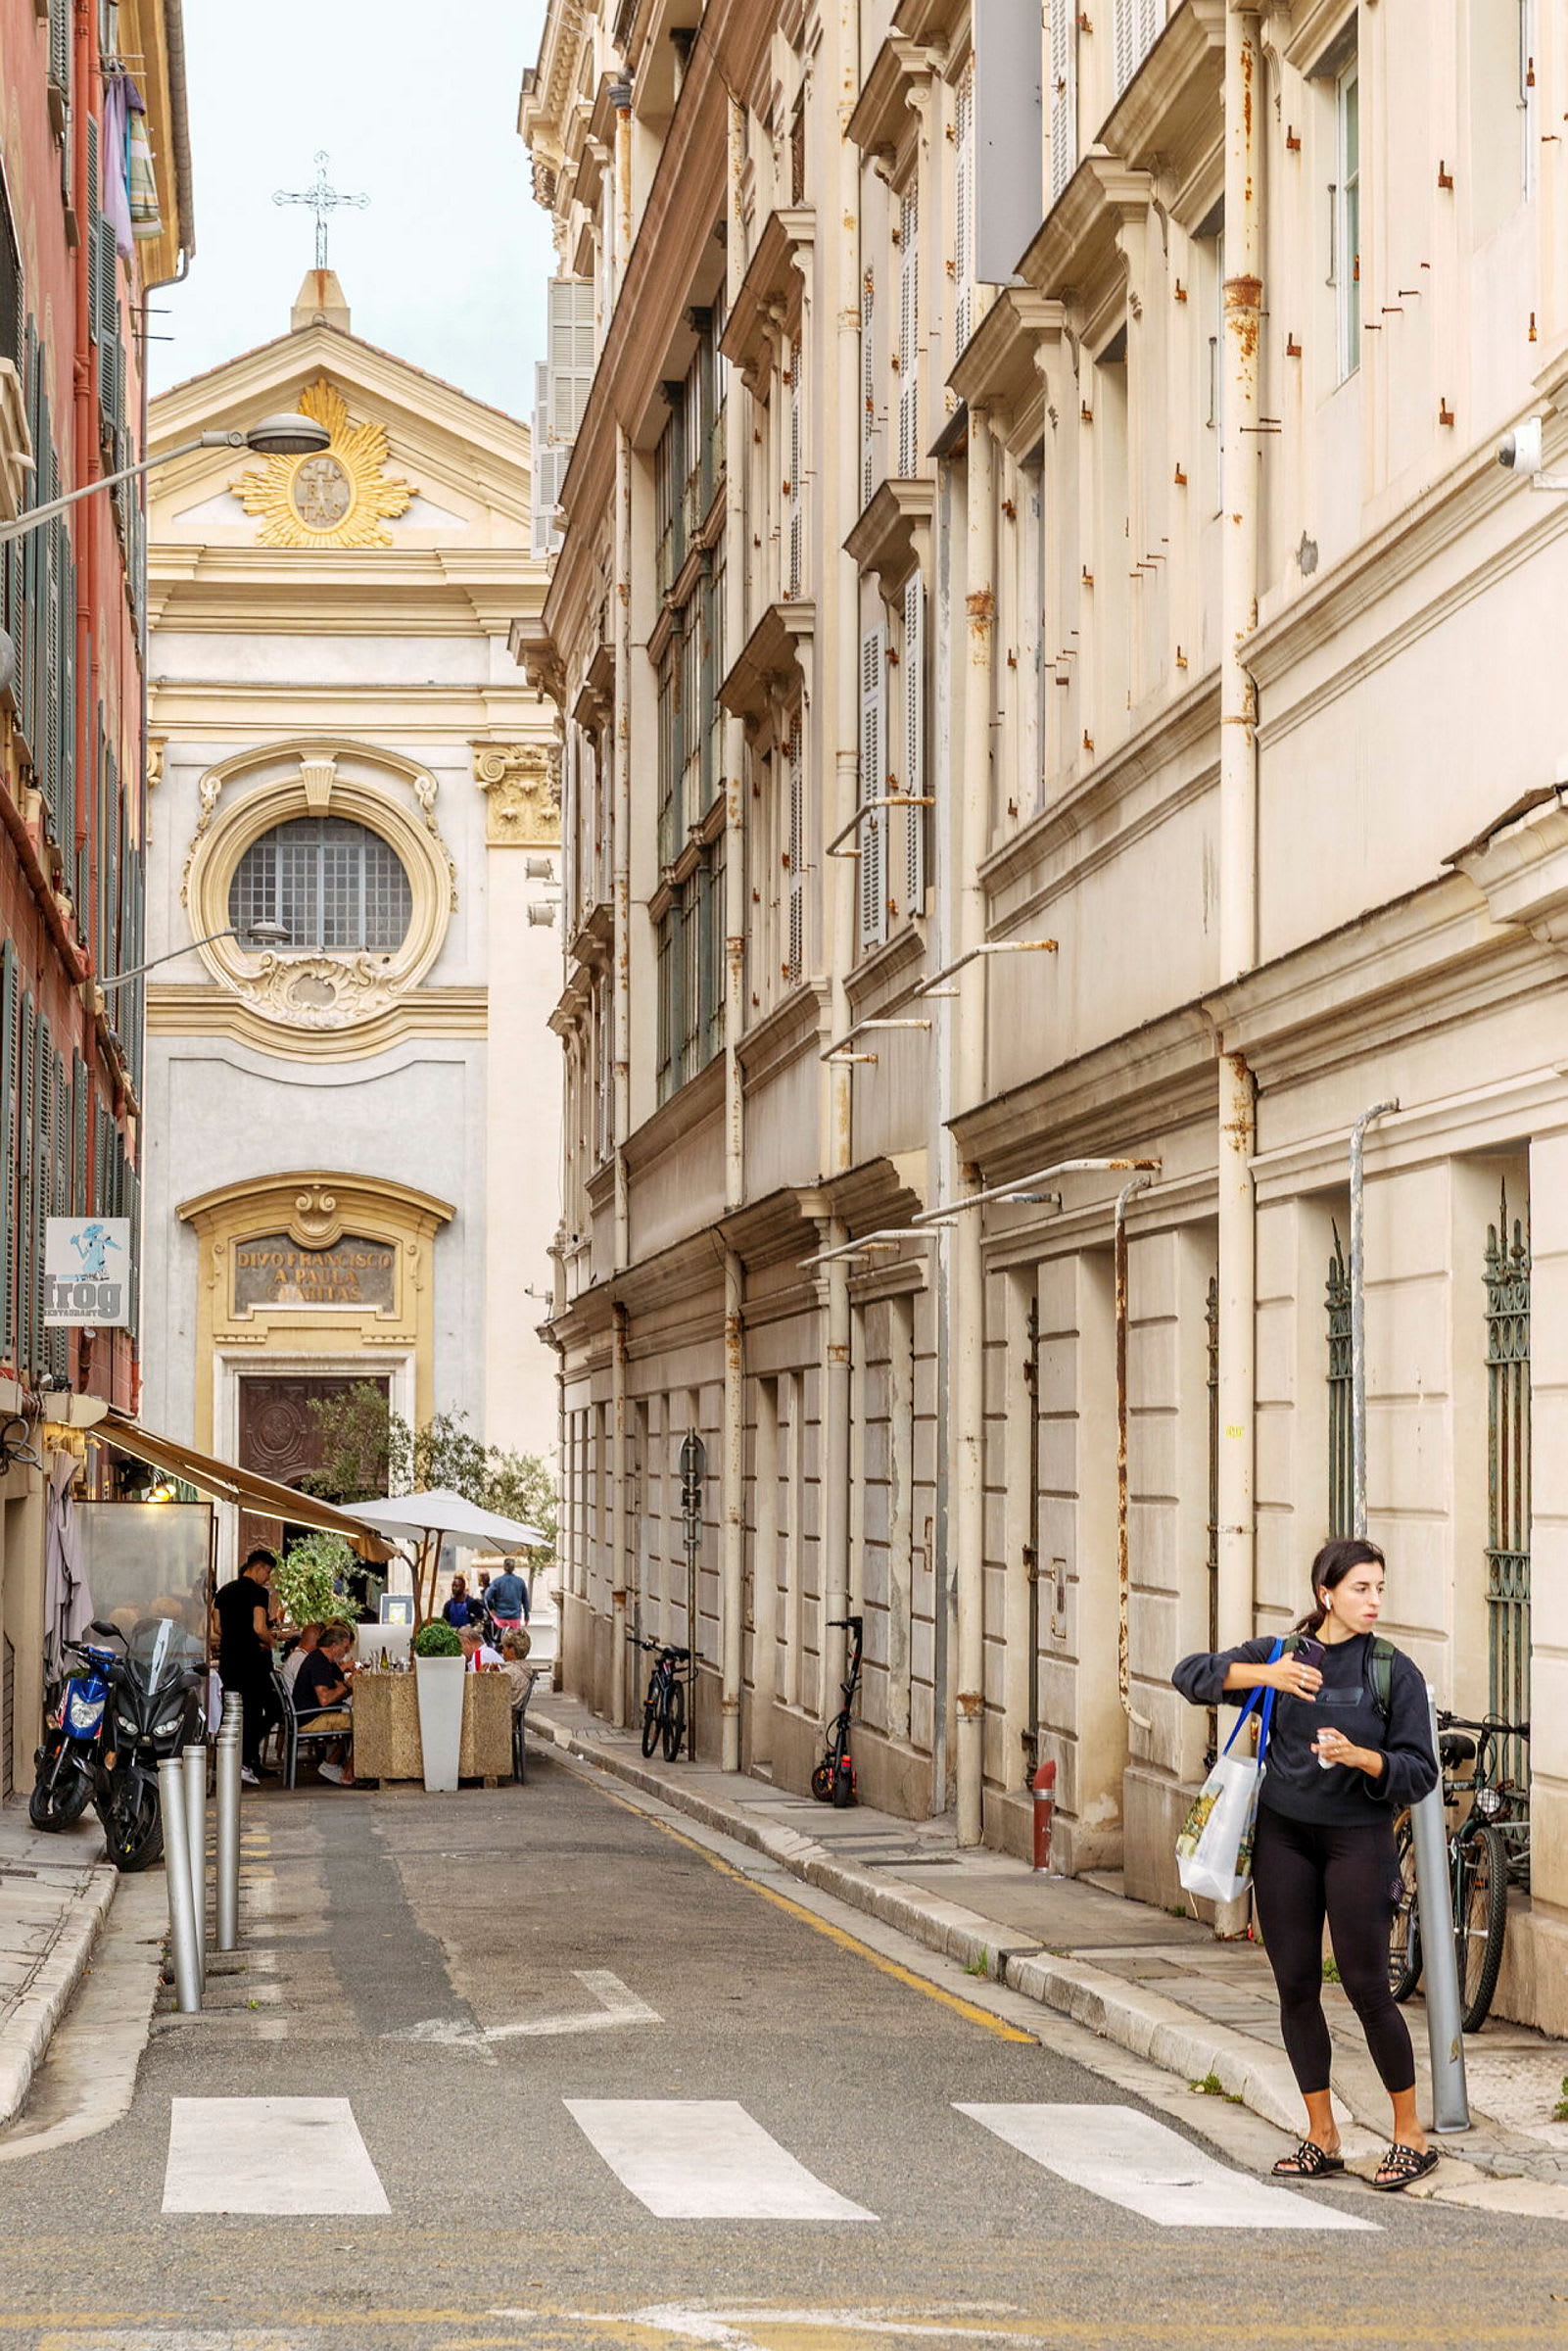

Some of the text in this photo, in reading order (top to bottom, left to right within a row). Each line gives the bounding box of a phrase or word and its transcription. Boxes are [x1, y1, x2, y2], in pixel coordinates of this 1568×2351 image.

[297, 504, 342, 522] TAS
[237, 1252, 393, 1270] DIVO FRANCISCO
[274, 1269, 359, 1285] A PAULA
[44, 1273, 122, 1319] frog
